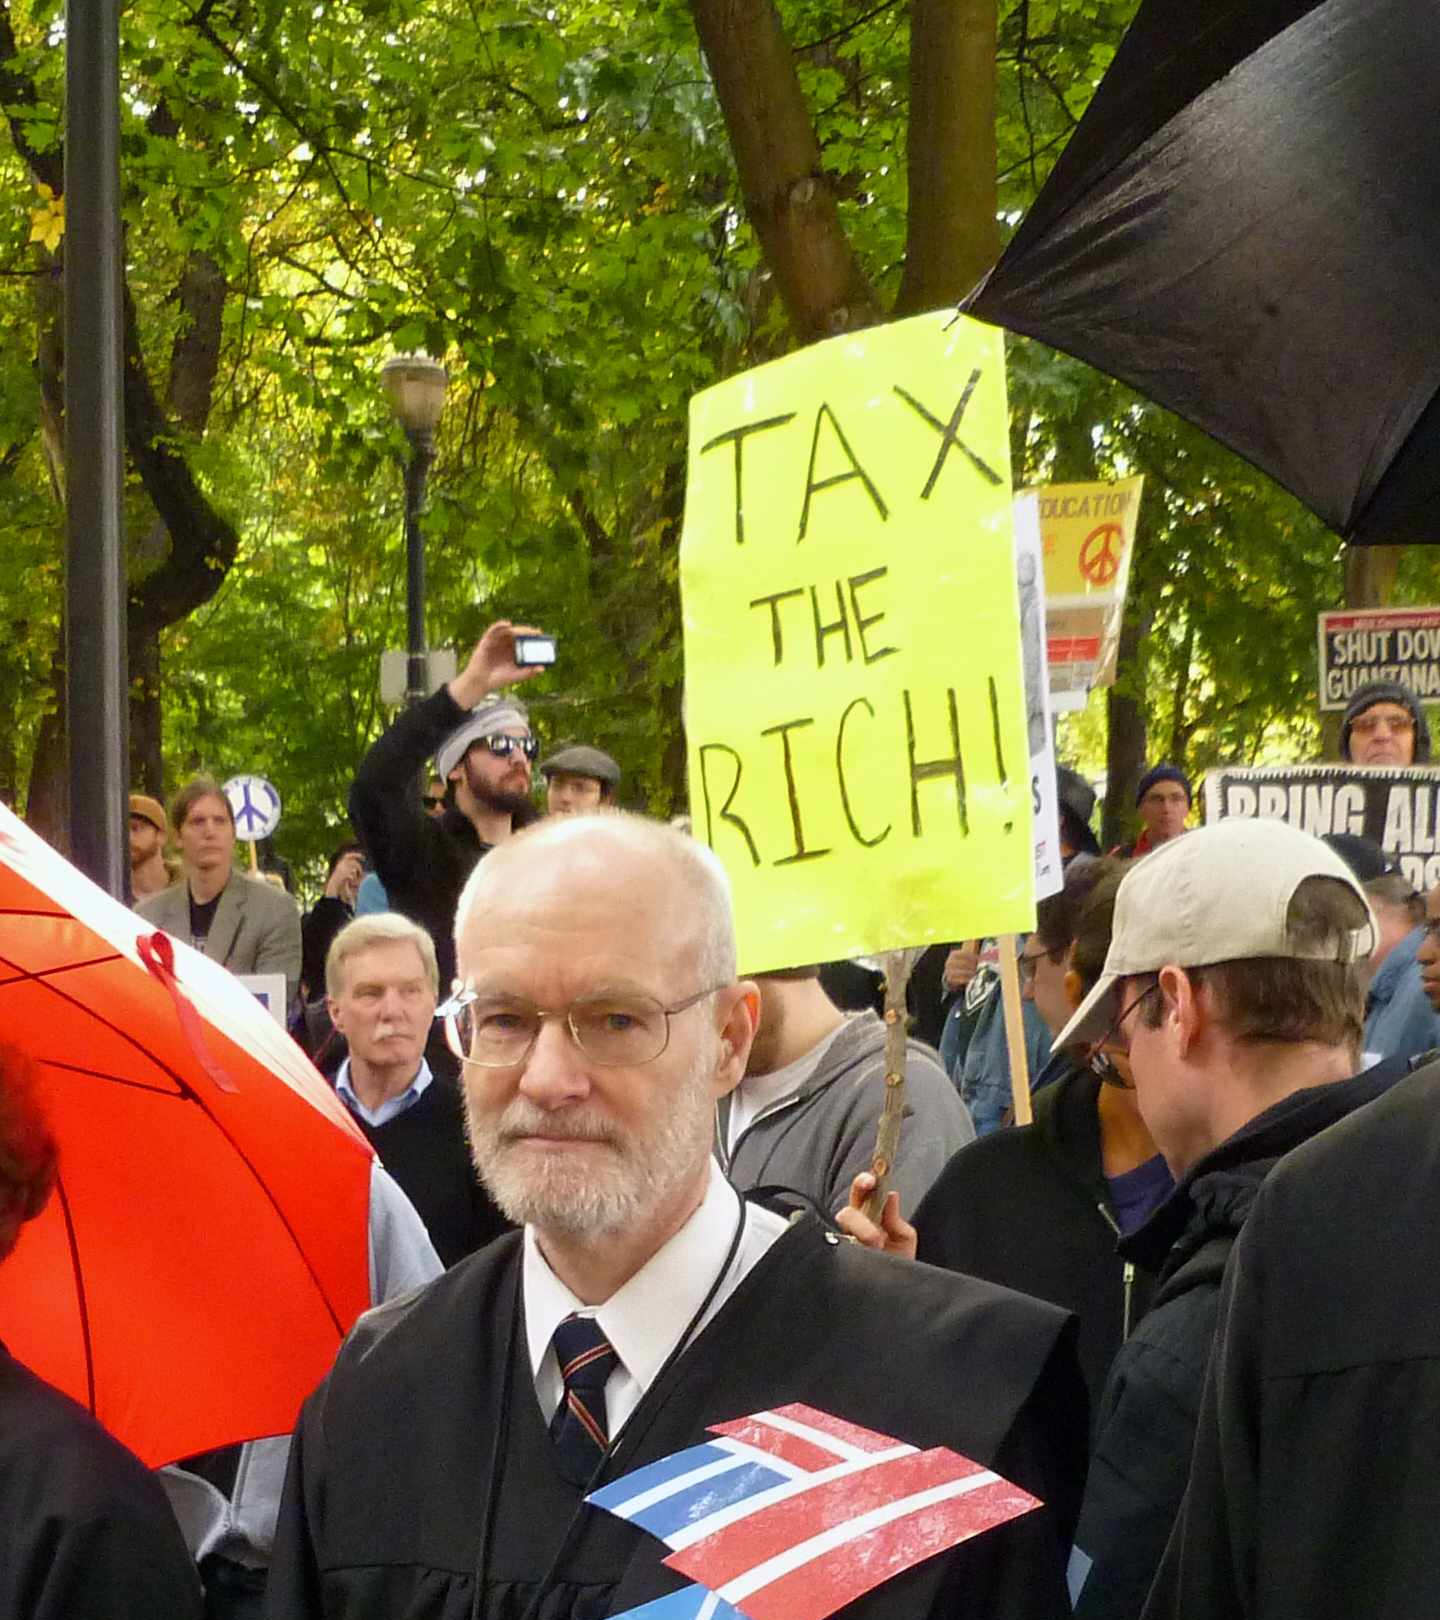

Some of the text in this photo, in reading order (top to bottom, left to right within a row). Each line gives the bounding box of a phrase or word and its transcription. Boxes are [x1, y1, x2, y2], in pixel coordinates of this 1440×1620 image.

[699, 367, 1004, 545] TAX
[1039, 490, 1132, 519] DUCATION
[749, 566, 900, 667] THE
[1333, 631, 1392, 666] SHUT
[696, 675, 1015, 869] RICH!
